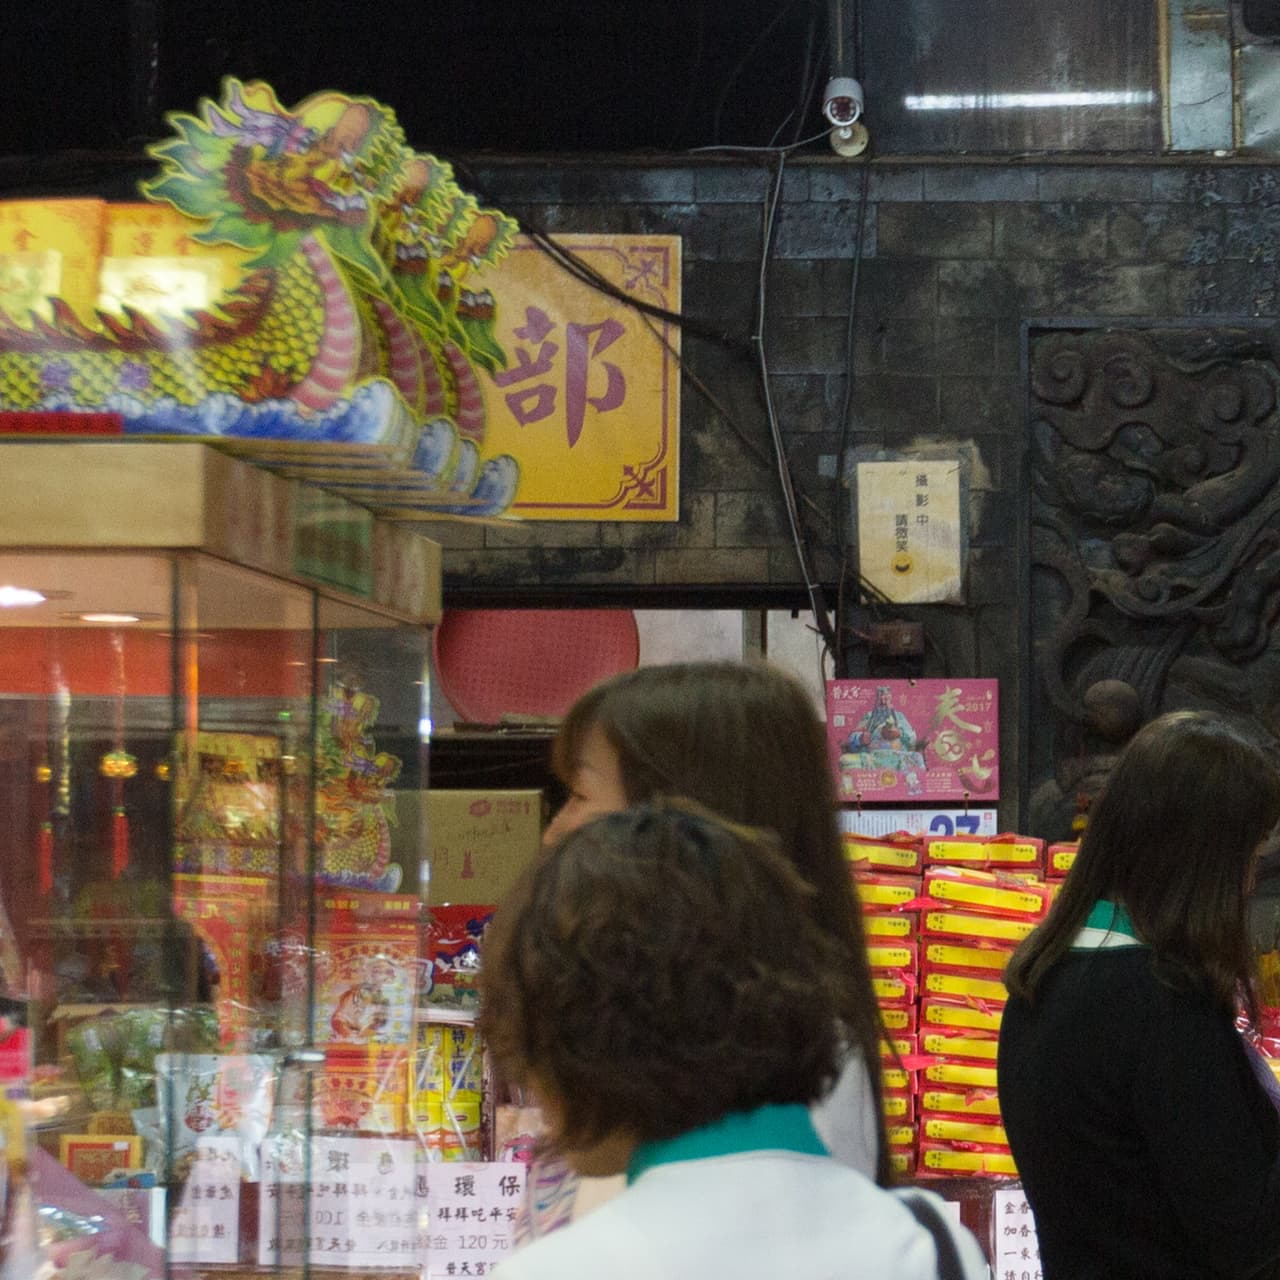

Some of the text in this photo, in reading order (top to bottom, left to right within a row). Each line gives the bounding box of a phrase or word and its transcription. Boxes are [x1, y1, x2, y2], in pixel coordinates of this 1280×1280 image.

[495, 306, 626, 448] 部
[915, 474, 929, 526] 攝影中
[965, 702, 992, 713] 2017
